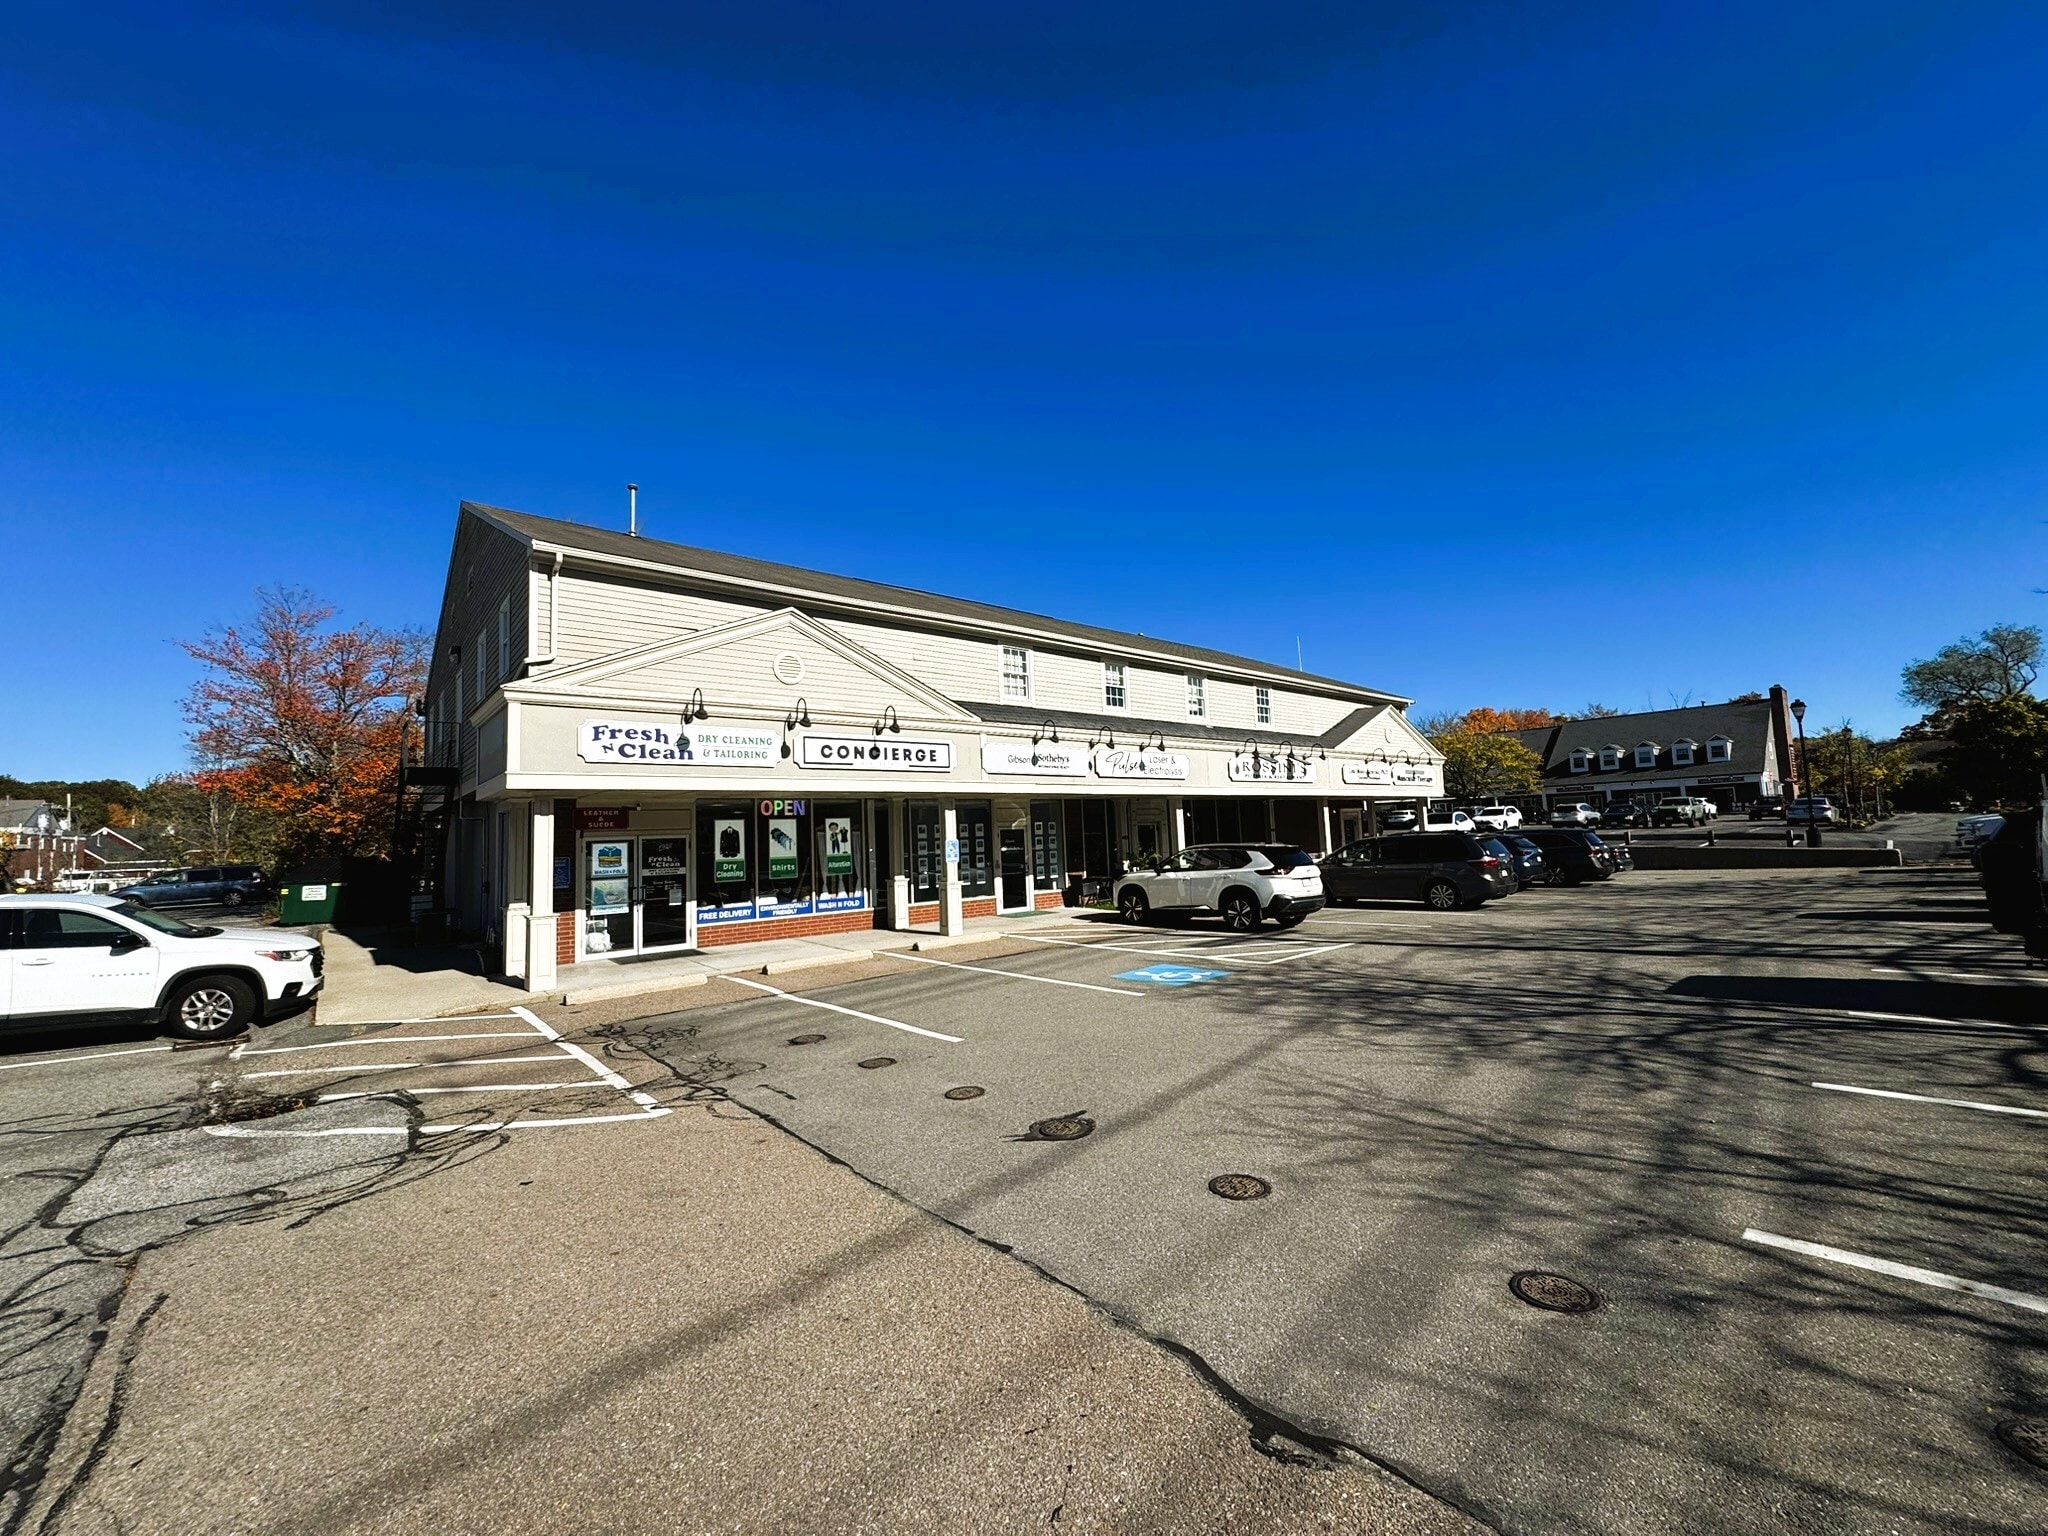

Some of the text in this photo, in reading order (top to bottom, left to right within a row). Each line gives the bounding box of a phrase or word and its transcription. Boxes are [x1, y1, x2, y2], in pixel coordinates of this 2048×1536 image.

[592, 724, 670, 744] Fresh
[698, 734, 773, 746] DRY CLEANING
[602, 743, 694, 760] N Clean
[703, 749, 768, 759] & TAILORING
[820, 744, 937, 762] CONCIERGE
[1008, 754, 1031, 764] Gibson
[1105, 751, 1138, 775] Pulse
[1149, 755, 1176, 764] Laser &
[760, 800, 806, 816] OPEN
[723, 863, 737, 872] Dry
[716, 870, 744, 878] Cleaning
[760, 902, 810, 912] ENVIRONMENTALLY
[818, 901, 837, 909] WASH
[843, 900, 860, 908] FOLD
[699, 909, 752, 920] FREE DELIVERY
[772, 908, 798, 916] FRIENDLY
